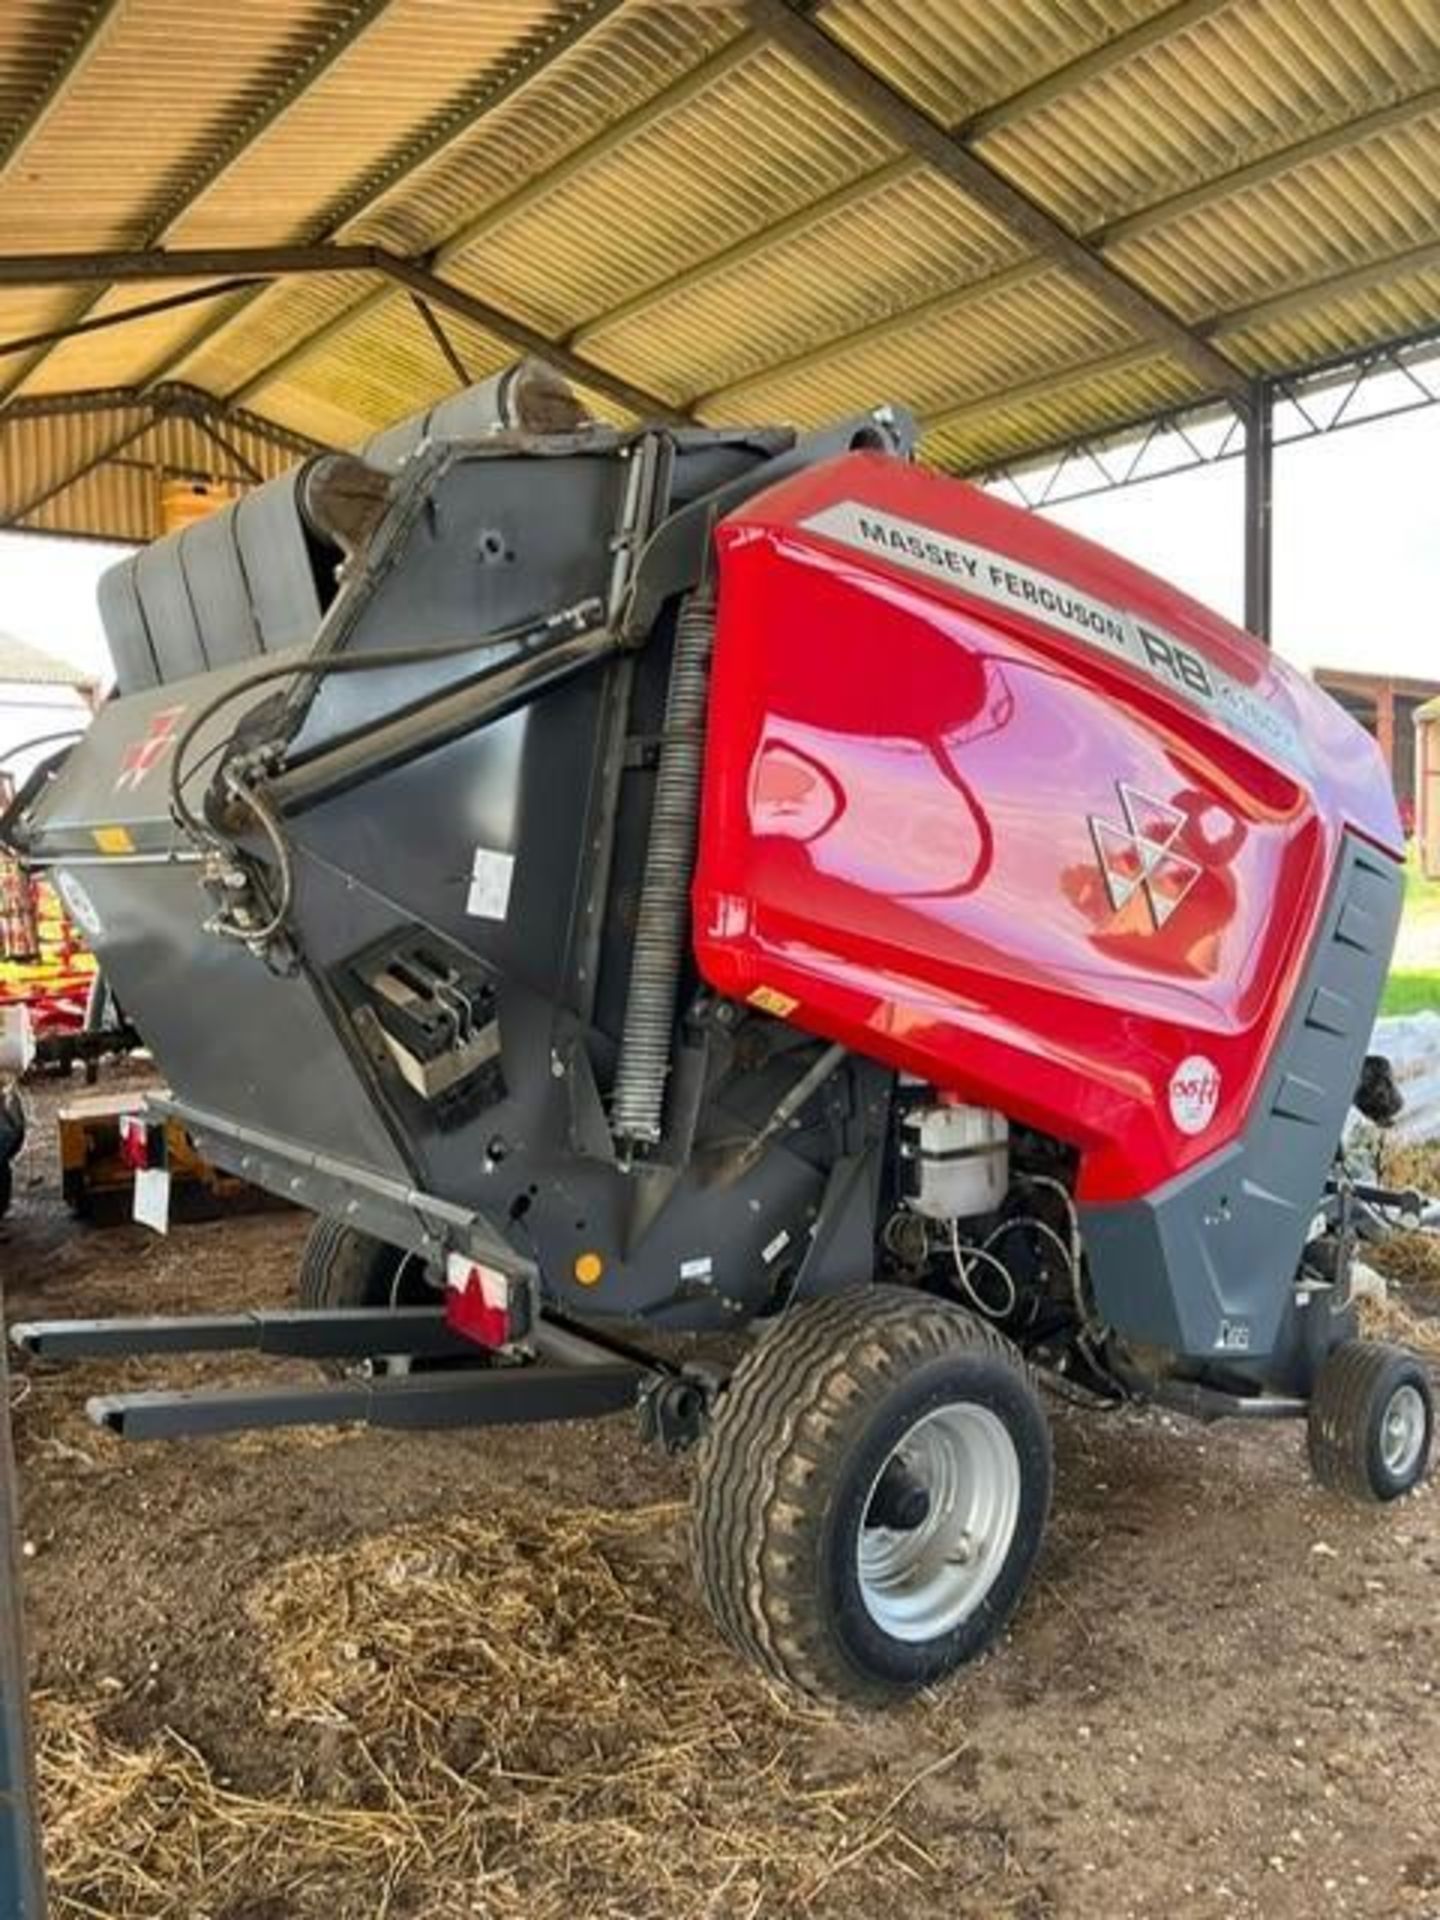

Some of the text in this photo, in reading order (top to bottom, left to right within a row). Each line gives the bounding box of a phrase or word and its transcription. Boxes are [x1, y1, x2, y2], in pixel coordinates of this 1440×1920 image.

[859, 518, 1213, 698] MASSEY FERGUSON RB
